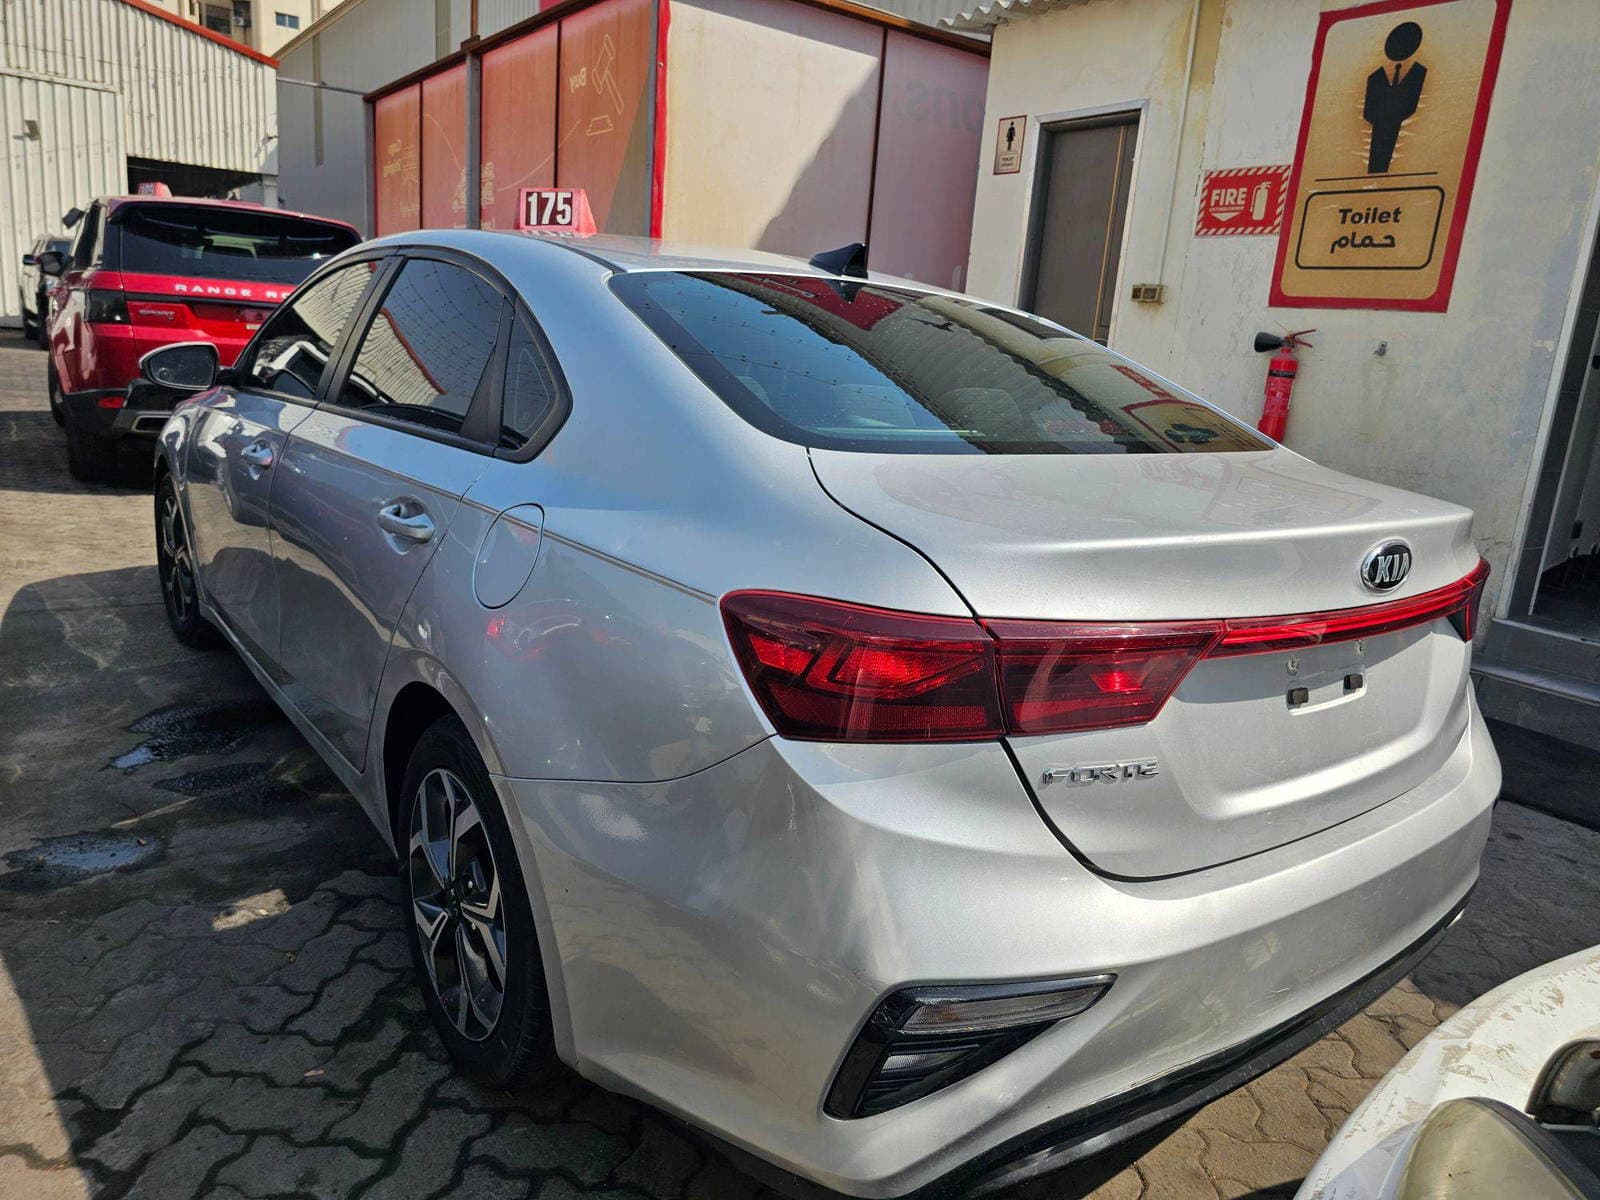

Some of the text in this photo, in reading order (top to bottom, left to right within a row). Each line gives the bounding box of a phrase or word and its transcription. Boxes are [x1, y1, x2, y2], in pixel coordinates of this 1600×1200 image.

[528, 191, 572, 226] 175
[1210, 187, 1248, 207] FIRE
[1338, 206, 1402, 224] Toilet
[1330, 231, 1396, 254] حمام
[174, 283, 252, 297] RANGE
[1374, 552, 1410, 583] KIA
[1039, 760, 1160, 787] FORTE
